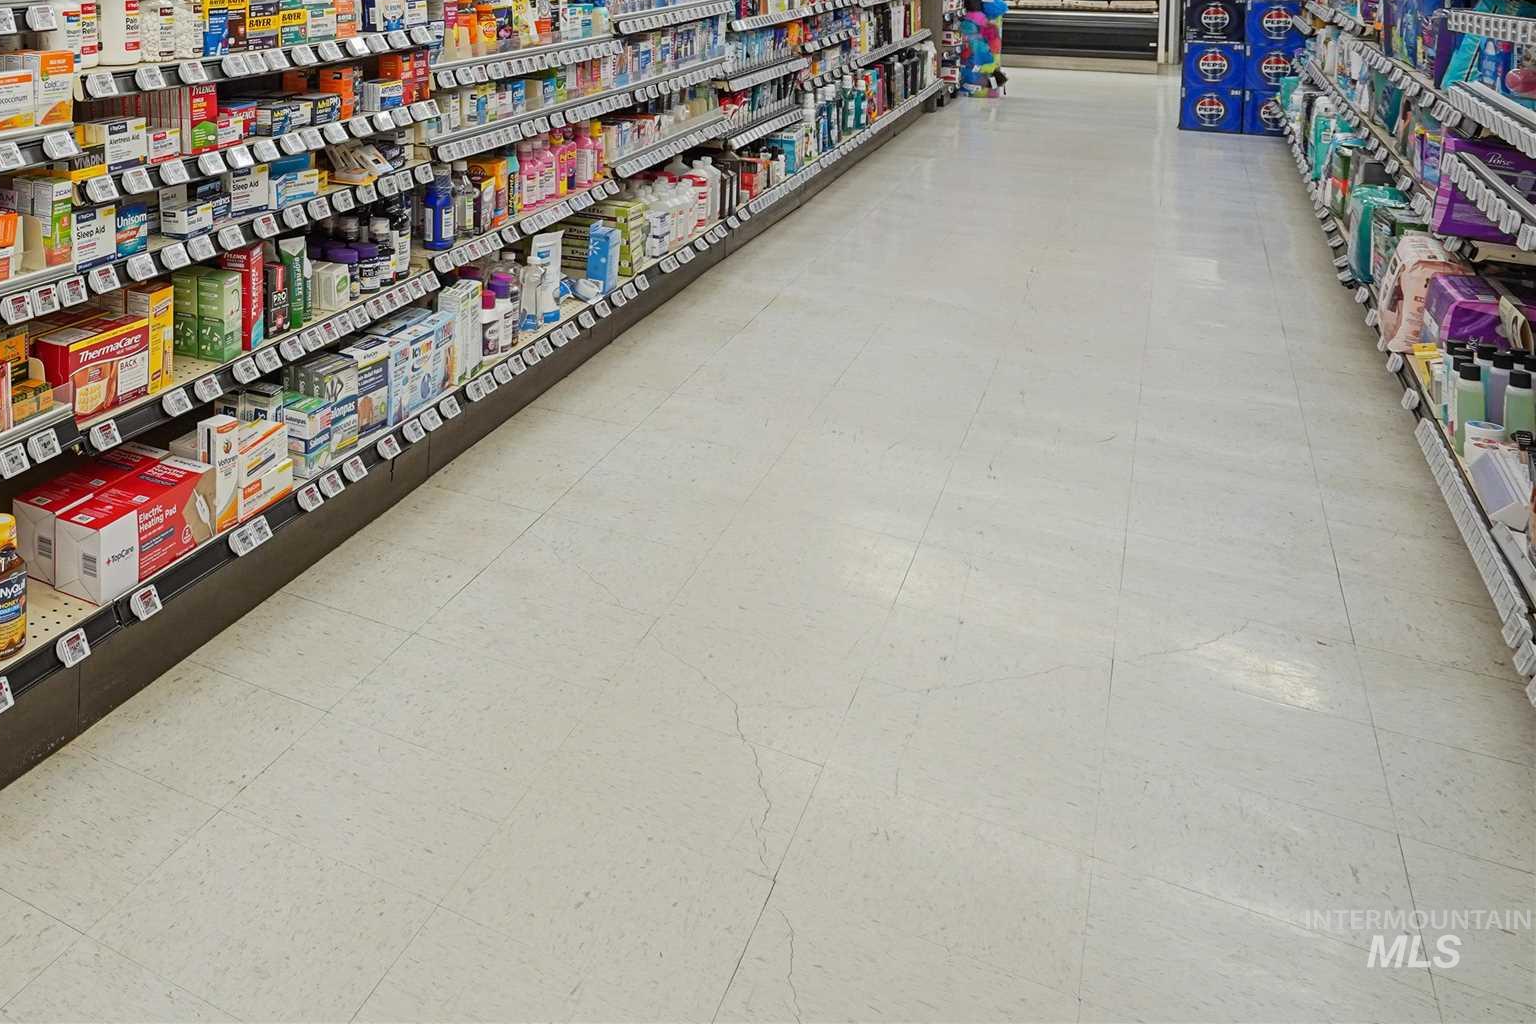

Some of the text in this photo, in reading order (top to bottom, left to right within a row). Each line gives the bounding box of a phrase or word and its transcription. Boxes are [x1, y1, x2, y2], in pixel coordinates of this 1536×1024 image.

[249, 19, 271, 27] BAYER
[232, 181, 258, 194] Sleep Aid
[117, 213, 147, 227] Unisom
[76, 225, 106, 240] Sleep Aid
[79, 333, 142, 363] ThermaCare
[119, 358, 138, 372] BACK
[139, 505, 163, 523] Electric
[139, 504, 177, 533] Heating Pad
[111, 545, 135, 564] TopCare
[0, 577, 26, 598] NyQuil
